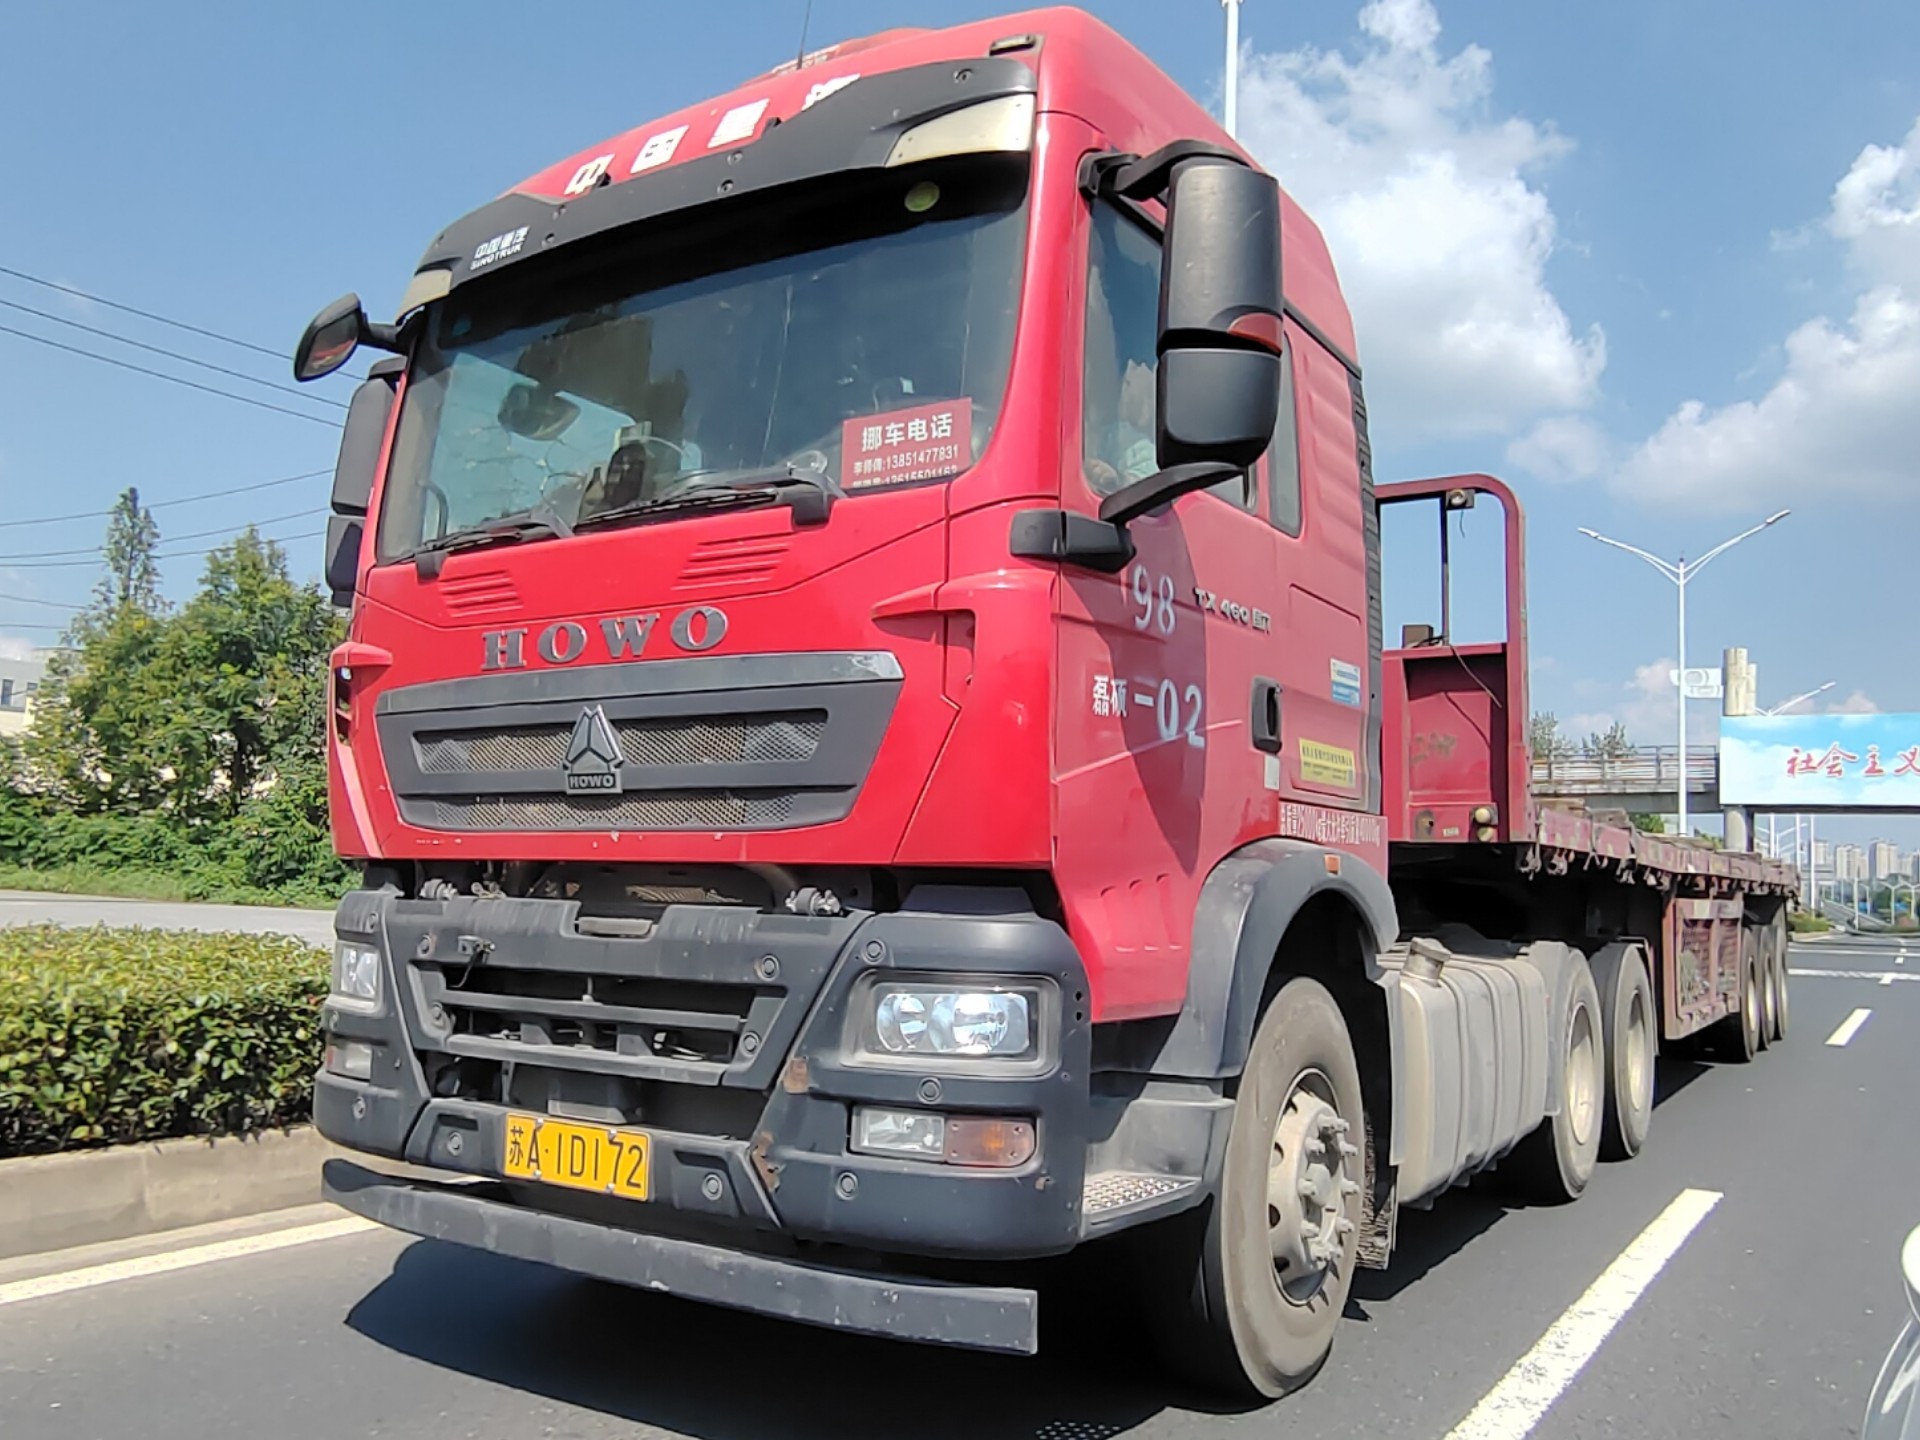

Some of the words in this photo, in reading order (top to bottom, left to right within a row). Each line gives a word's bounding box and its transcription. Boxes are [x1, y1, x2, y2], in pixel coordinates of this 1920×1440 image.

[862, 413, 952, 452] 挪车电话
[481, 606, 728, 671] HOWO
[569, 774, 615, 790] HOWO
